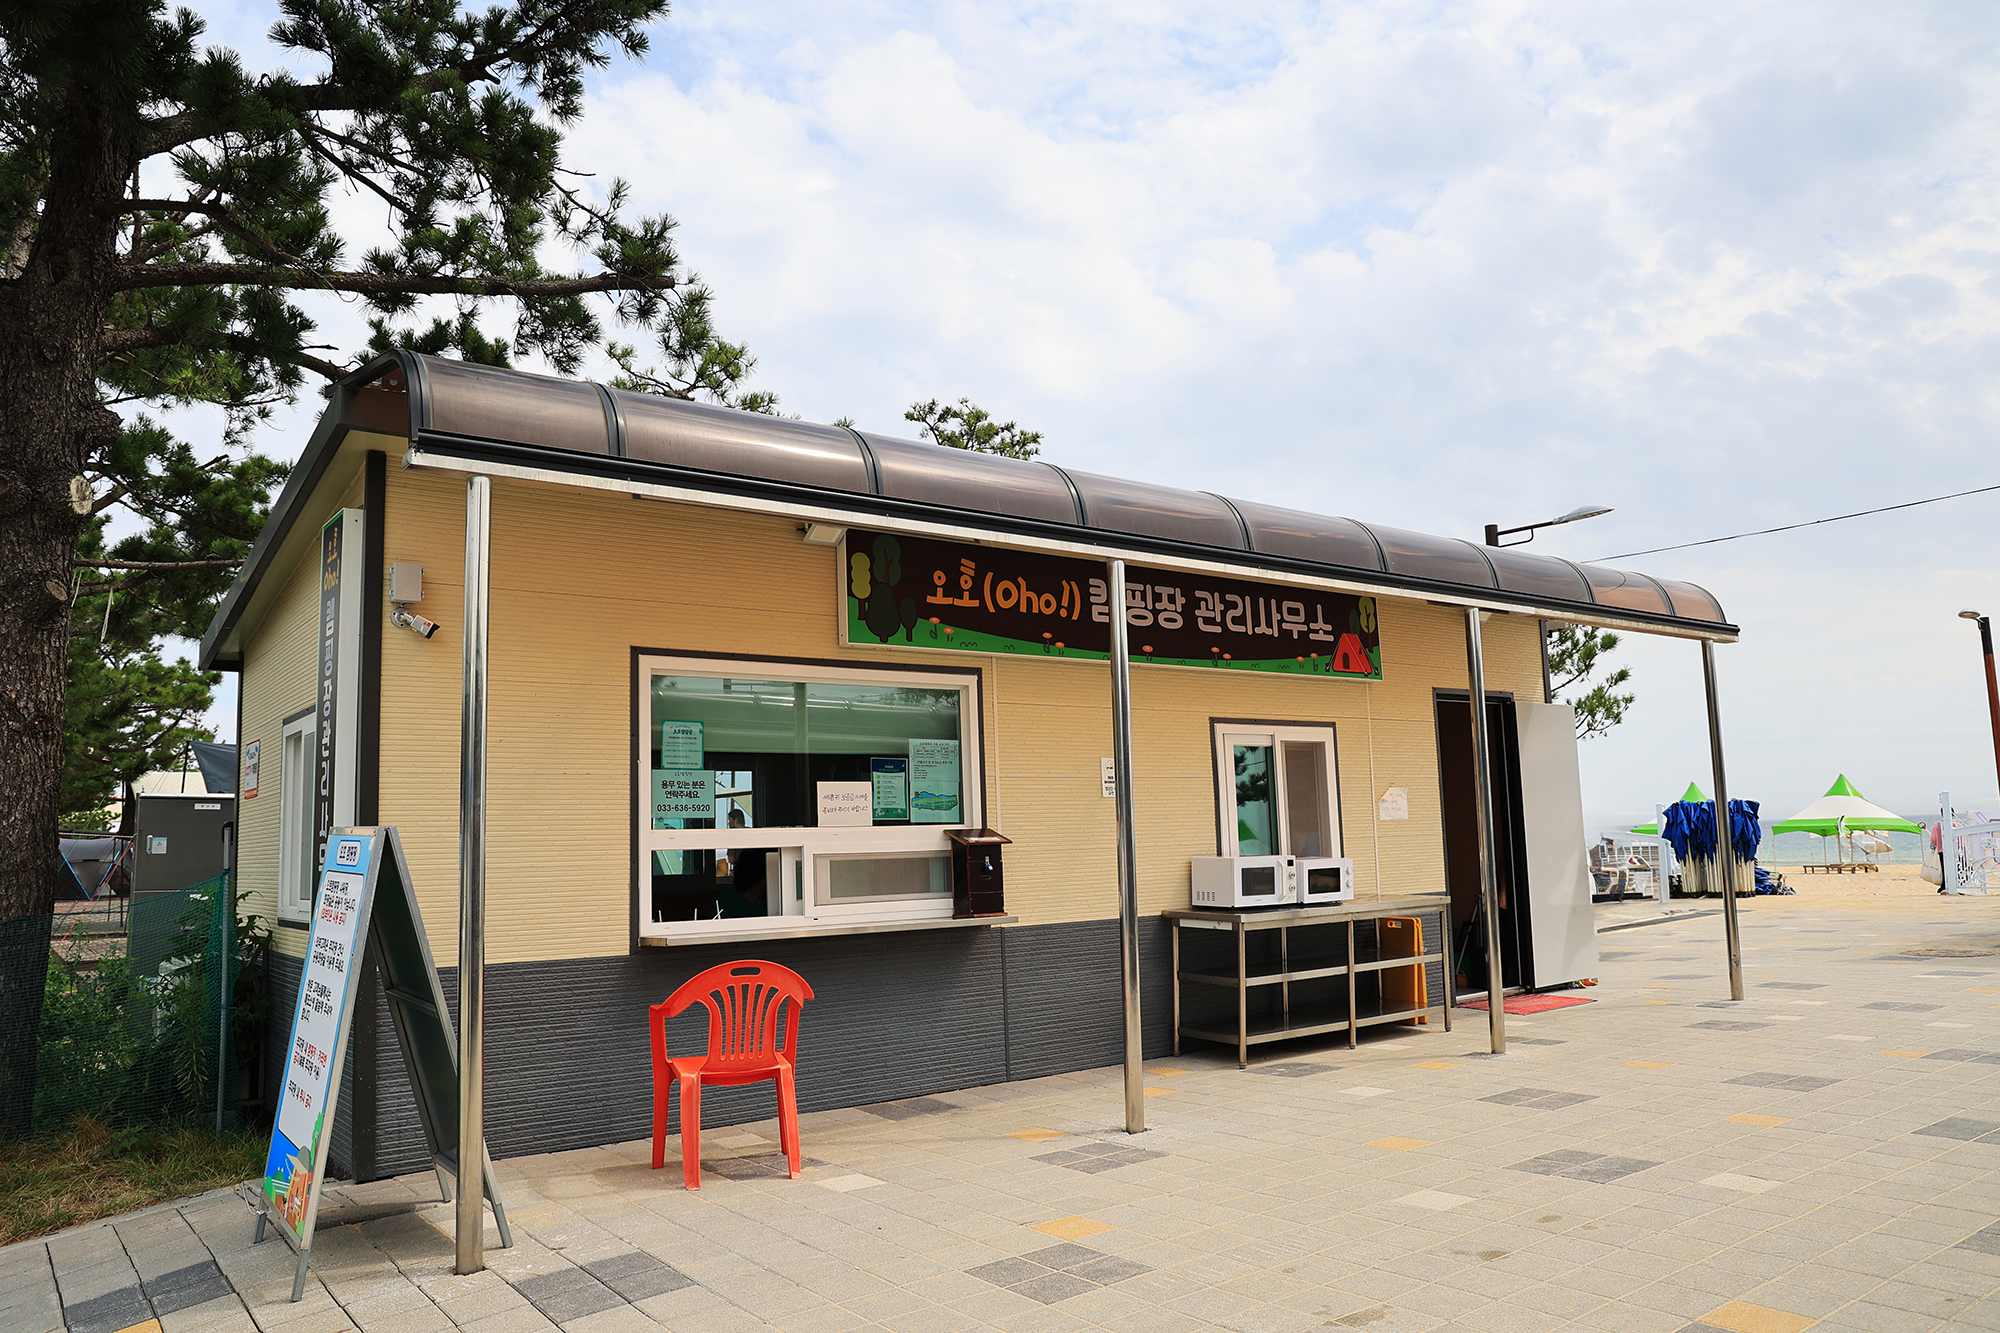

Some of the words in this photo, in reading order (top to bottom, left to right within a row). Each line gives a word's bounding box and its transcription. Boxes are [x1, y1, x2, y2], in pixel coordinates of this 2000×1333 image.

[327, 526, 338, 564] 오호
[1194, 589, 1335, 642] 관리사무소
[661, 780, 676, 789] 용무
[676, 780, 691, 789] 있는
[691, 780, 706, 789] 분은
[664, 790, 701, 799] 연락주세요.
[657, 804, 711, 812] 033-636-5920
